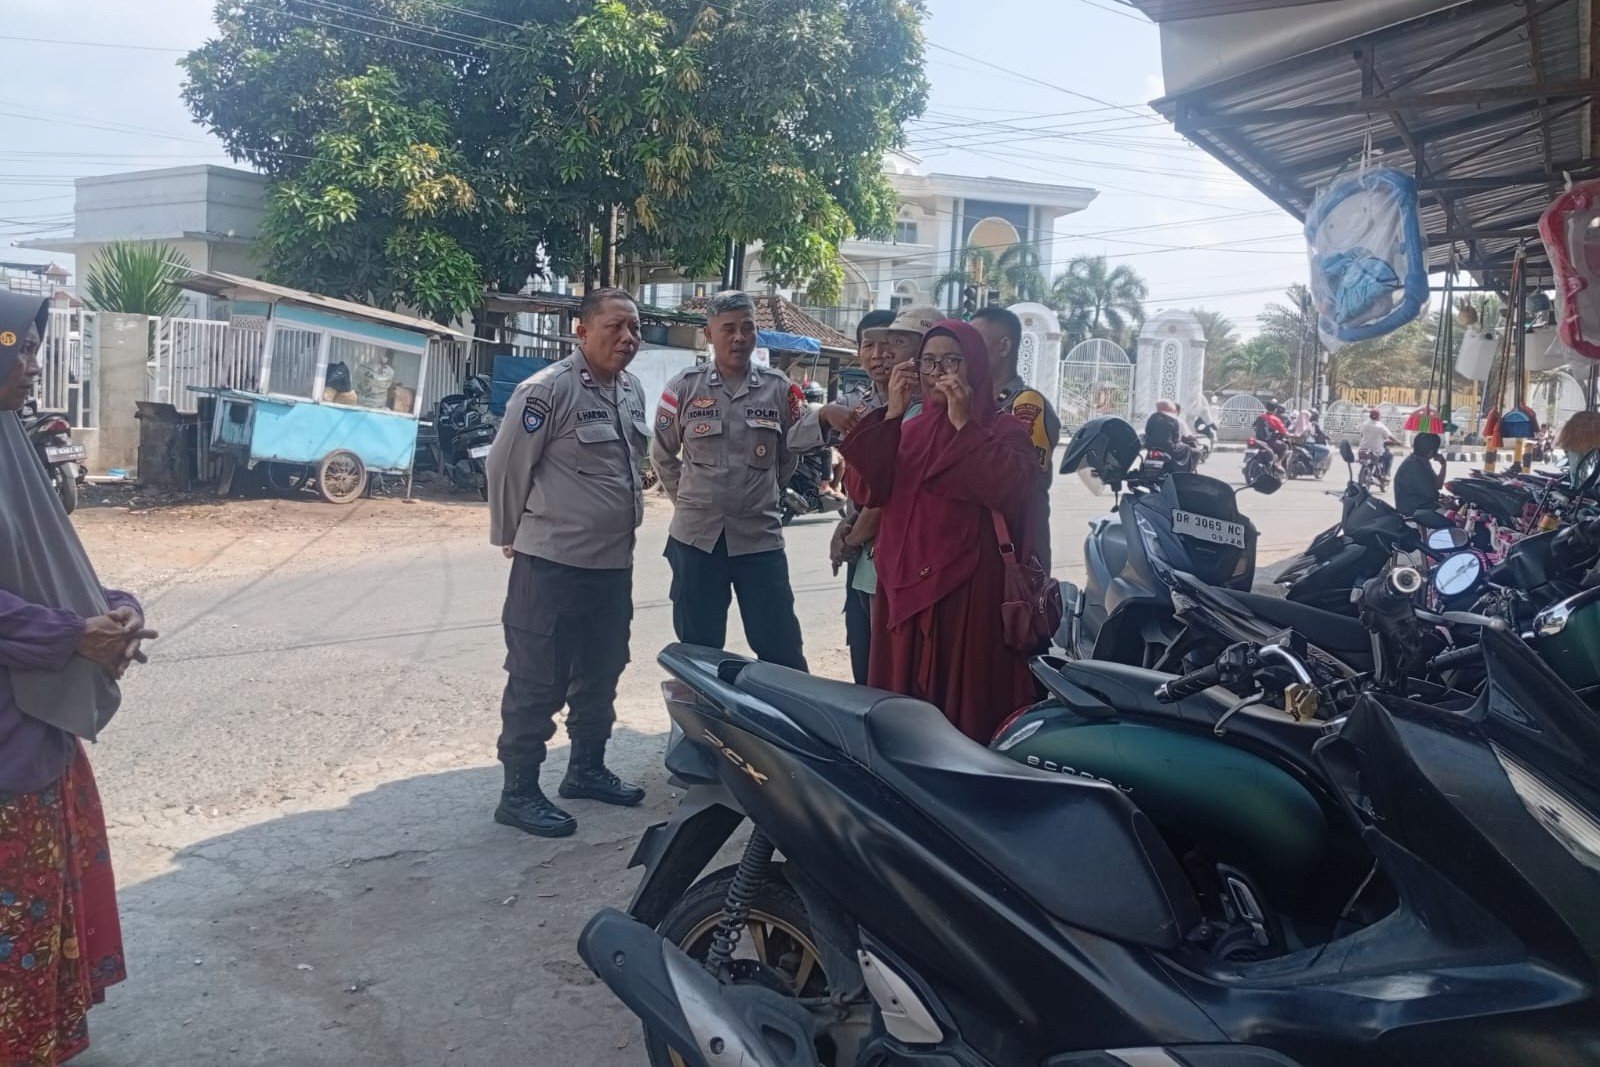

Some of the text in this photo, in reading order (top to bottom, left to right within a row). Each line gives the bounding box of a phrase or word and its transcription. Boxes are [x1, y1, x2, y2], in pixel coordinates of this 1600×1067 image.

[747, 408, 778, 418] POLRI
[1176, 512, 1242, 536] DR 3065 NC
[702, 728, 769, 785] PCX
